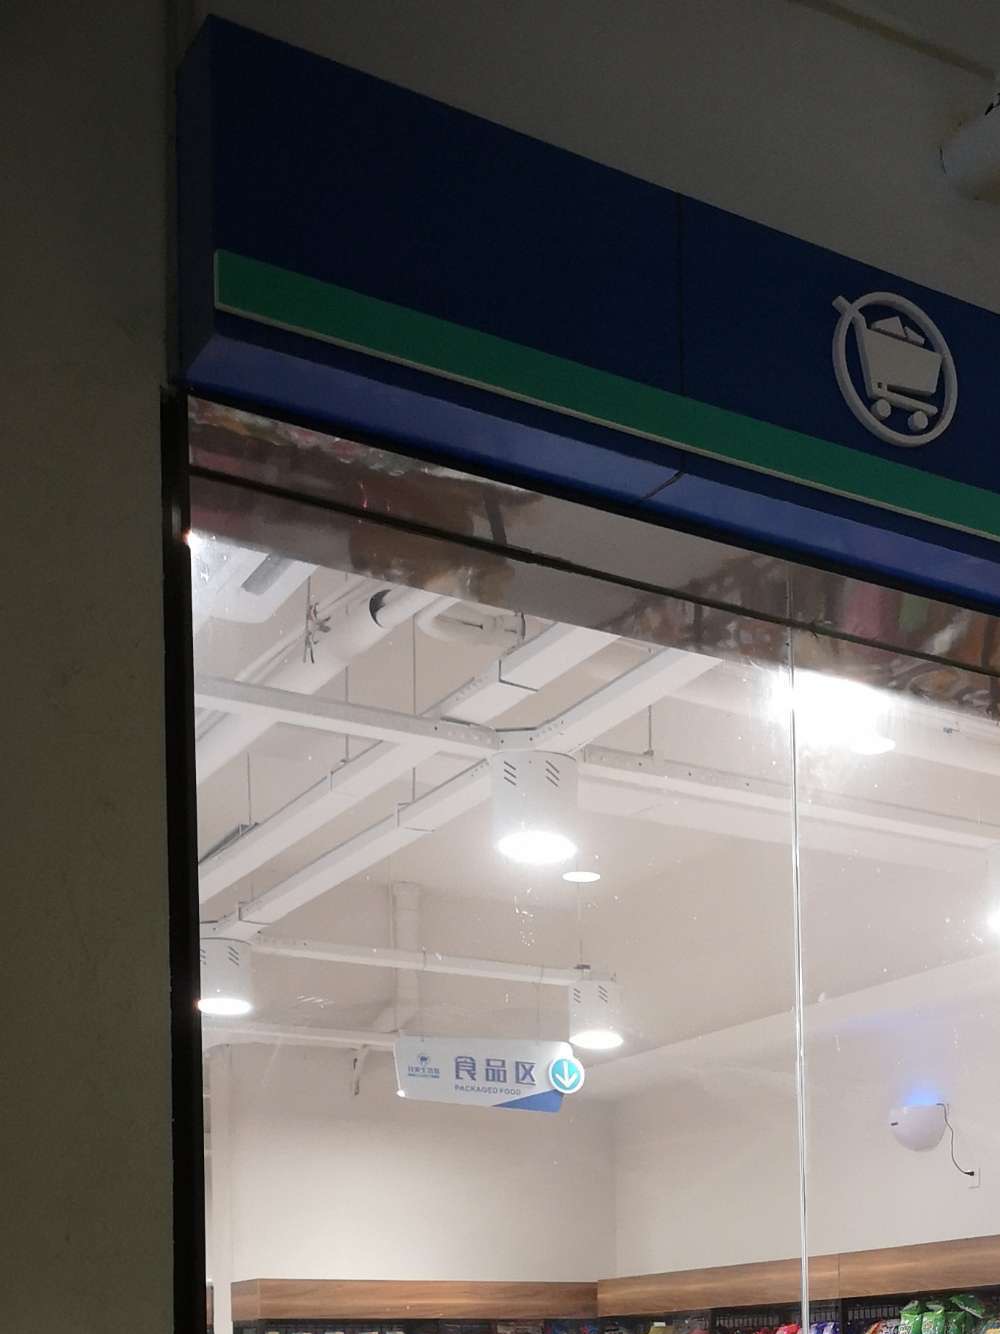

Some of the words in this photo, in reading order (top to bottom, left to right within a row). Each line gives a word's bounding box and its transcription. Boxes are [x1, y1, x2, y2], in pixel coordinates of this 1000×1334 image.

[454, 1056, 537, 1085] 食品区
[454, 1084, 498, 1095] PACKAGED
